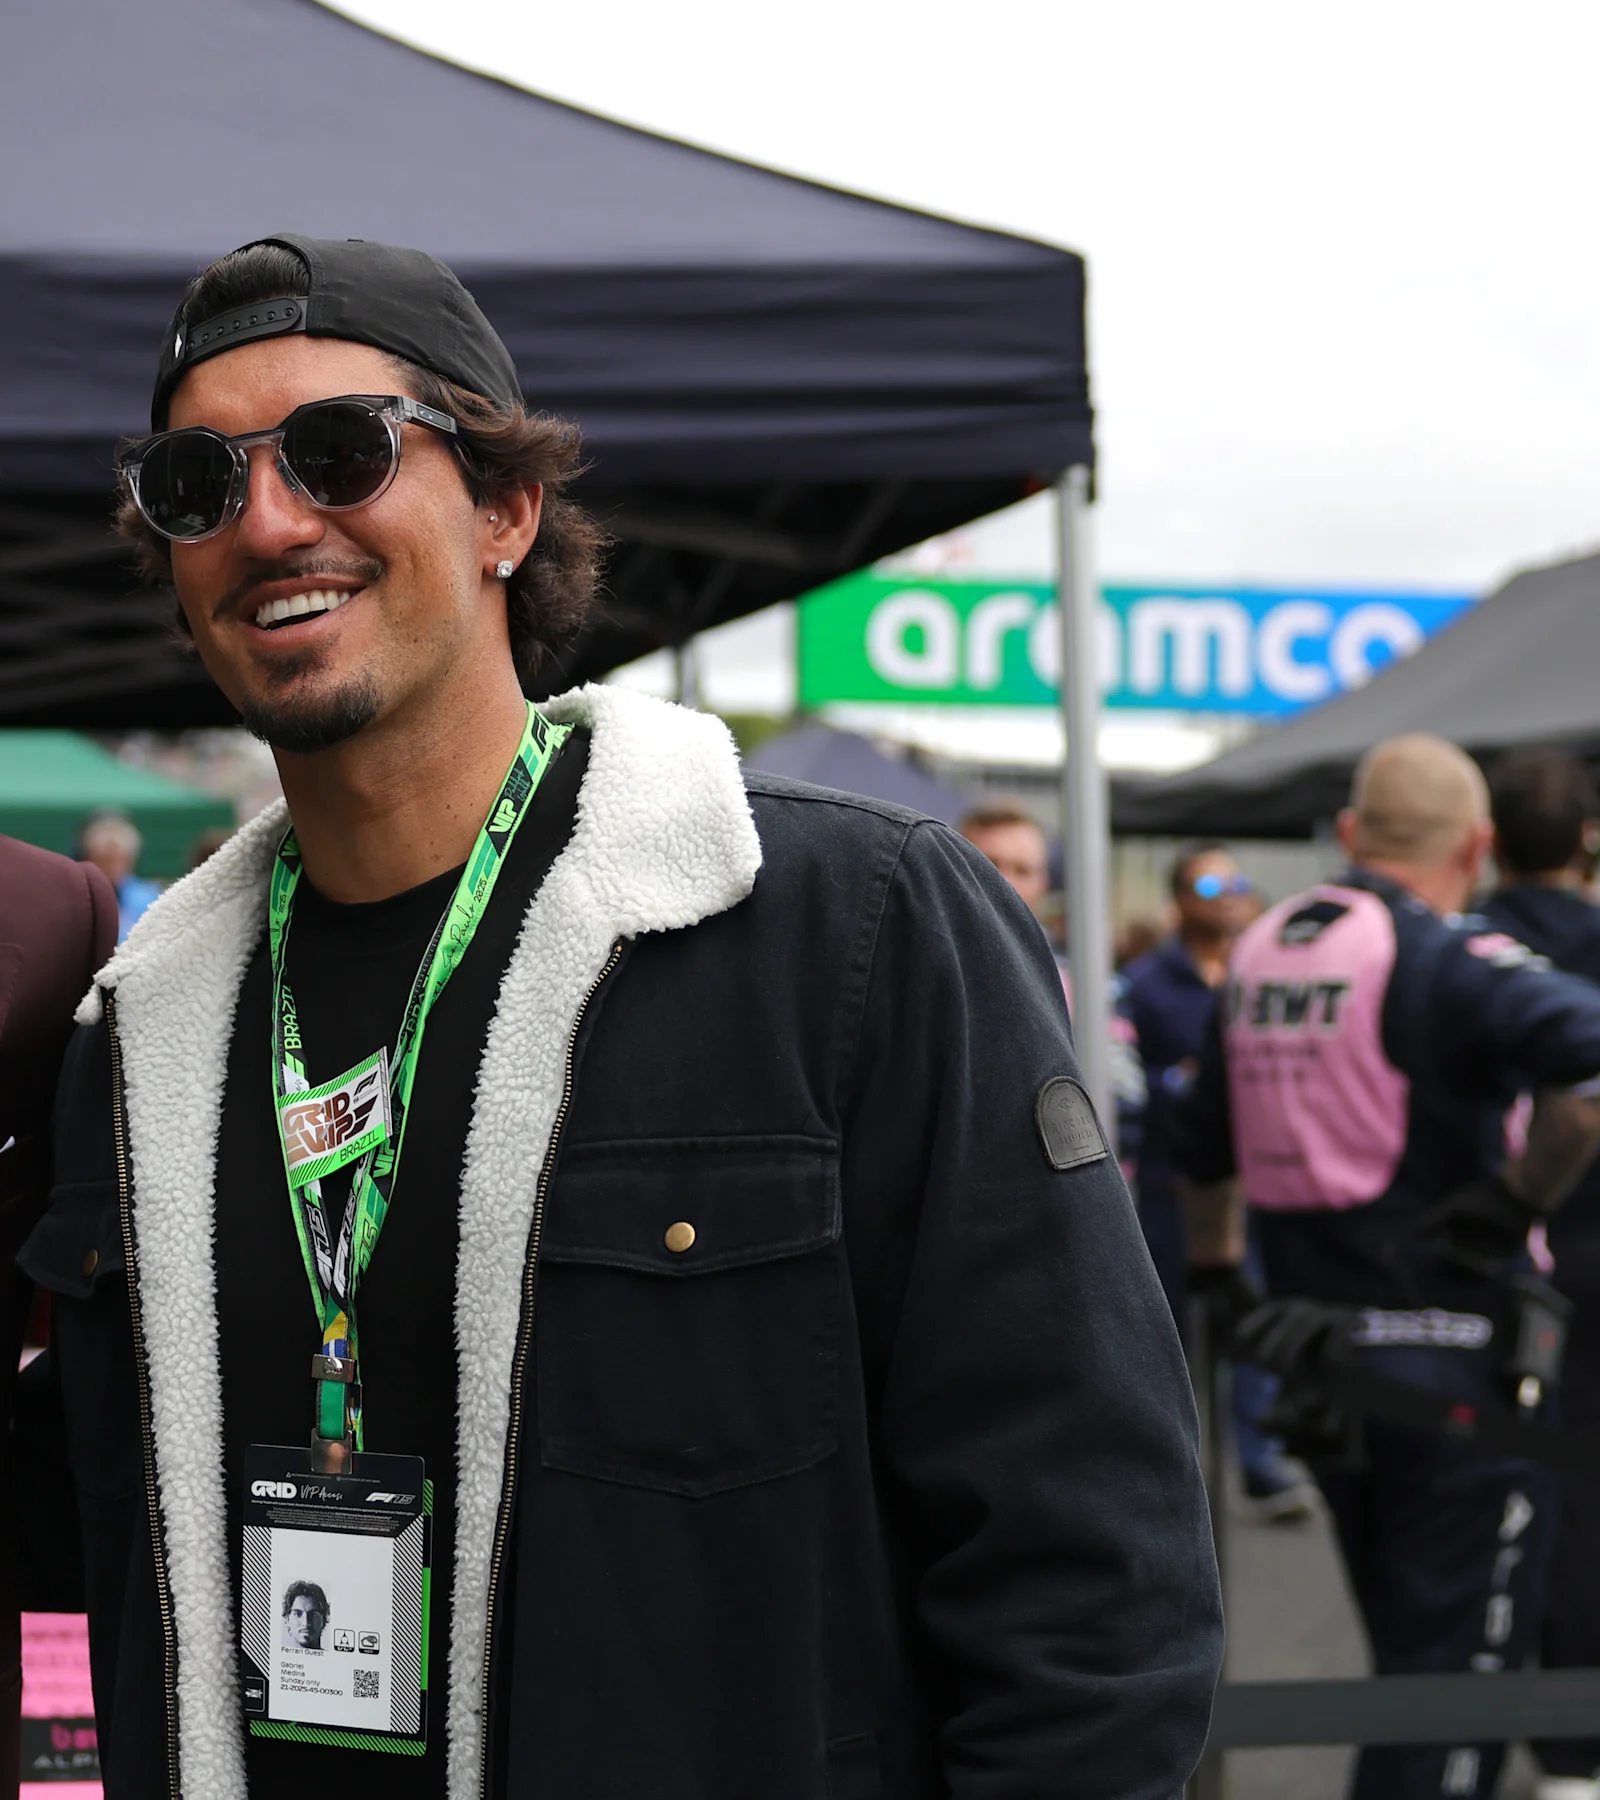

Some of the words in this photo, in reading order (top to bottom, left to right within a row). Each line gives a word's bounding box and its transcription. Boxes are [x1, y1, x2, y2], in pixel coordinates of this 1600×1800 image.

[866, 591, 1424, 698] aramco
[488, 798, 518, 832] VIP
[450, 904, 475, 947] Paulo
[474, 879, 487, 902] 2025
[354, 1070, 379, 1096] F1
[284, 1092, 350, 1134] GRID
[300, 1113, 353, 1154] VIP
[340, 1130, 380, 1162] BRAZIL
[251, 1480, 297, 1499] GRID
[300, 1485, 319, 1499] VIP
[318, 1485, 343, 1501] Access
[280, 1662, 304, 1670] Gabriel
[281, 1646, 304, 1655] Ferrari
[304, 1649, 324, 1657] Guest
[280, 1669, 306, 1678] Medina
[280, 1676, 305, 1686] Sunday
[306, 1679, 321, 1687] only
